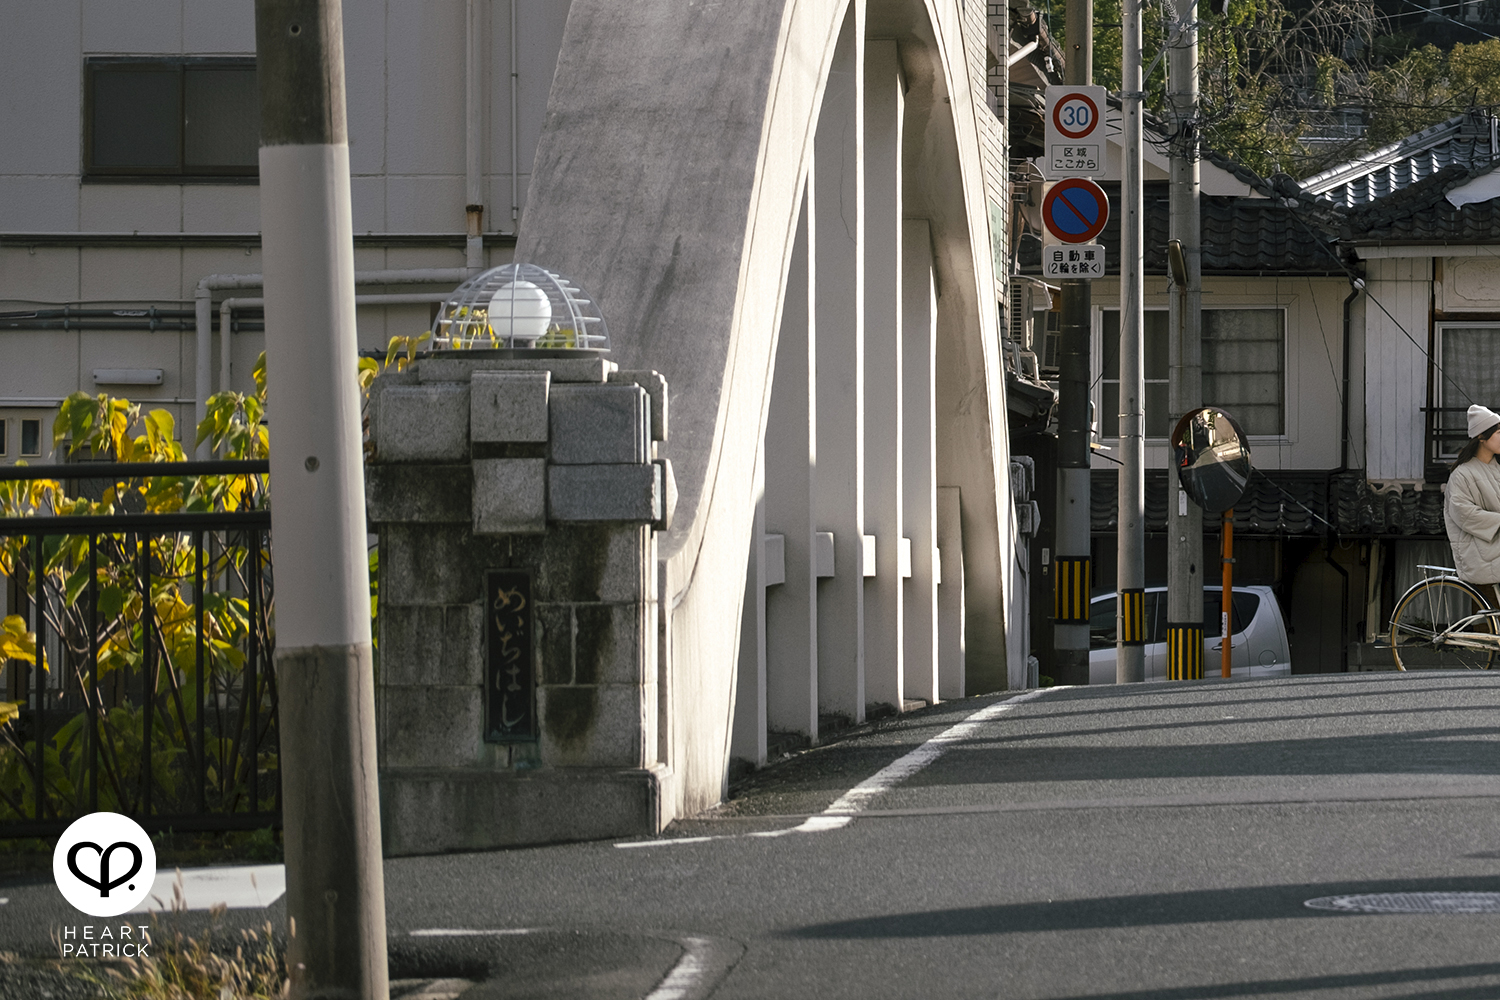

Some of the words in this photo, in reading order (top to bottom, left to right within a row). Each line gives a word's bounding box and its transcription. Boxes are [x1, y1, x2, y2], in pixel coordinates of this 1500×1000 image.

[1063, 106, 1089, 126] 30
[1063, 147, 1088, 157] 区域
[1054, 159, 1096, 169] ここから
[1053, 250, 1096, 262] 自動車
[1047, 262, 1101, 274] (2輪を除く)
[493, 585, 527, 728] めいぢはし
